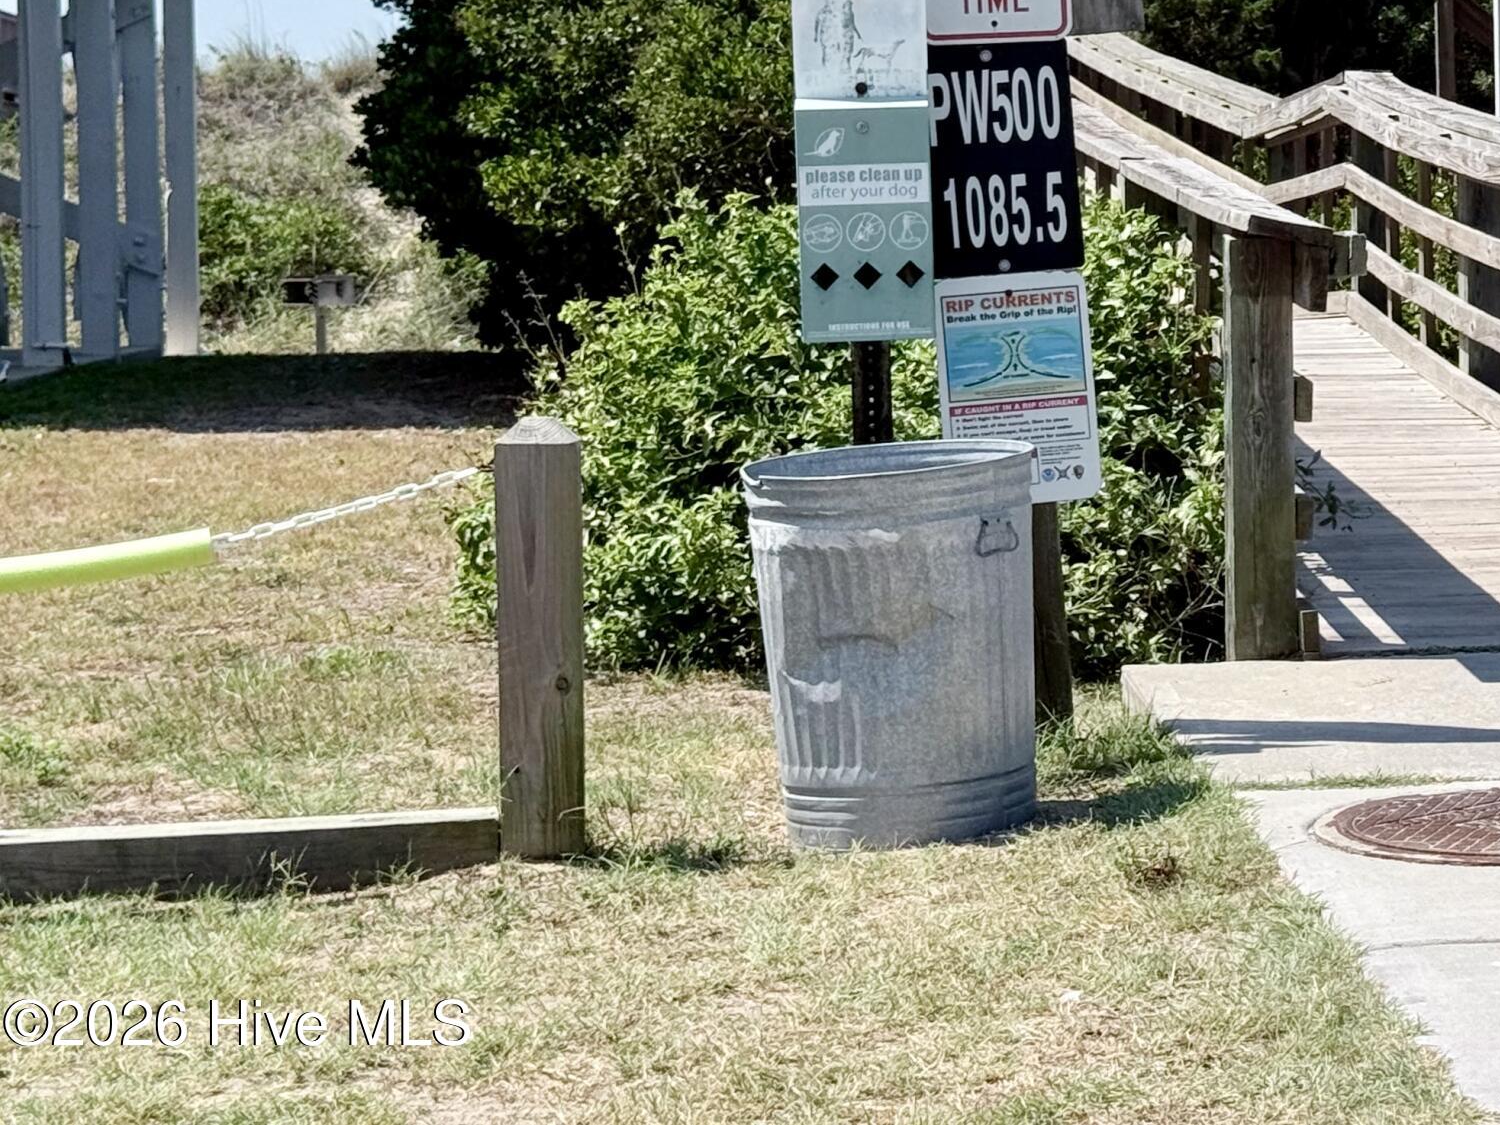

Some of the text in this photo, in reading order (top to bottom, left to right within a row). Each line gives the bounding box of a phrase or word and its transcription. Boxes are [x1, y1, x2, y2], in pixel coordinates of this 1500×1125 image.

[928, 65, 1061, 147] PW500
[805, 167, 923, 186] please clean up
[811, 183, 918, 201] after your dog
[943, 171, 1068, 249] 1085.5
[945, 290, 1076, 313] RIP CURRENTS
[946, 313, 977, 323] Break
[980, 312, 997, 322] the
[999, 310, 1021, 320] Grip
[1023, 308, 1035, 317] of
[1037, 307, 1055, 316] the
